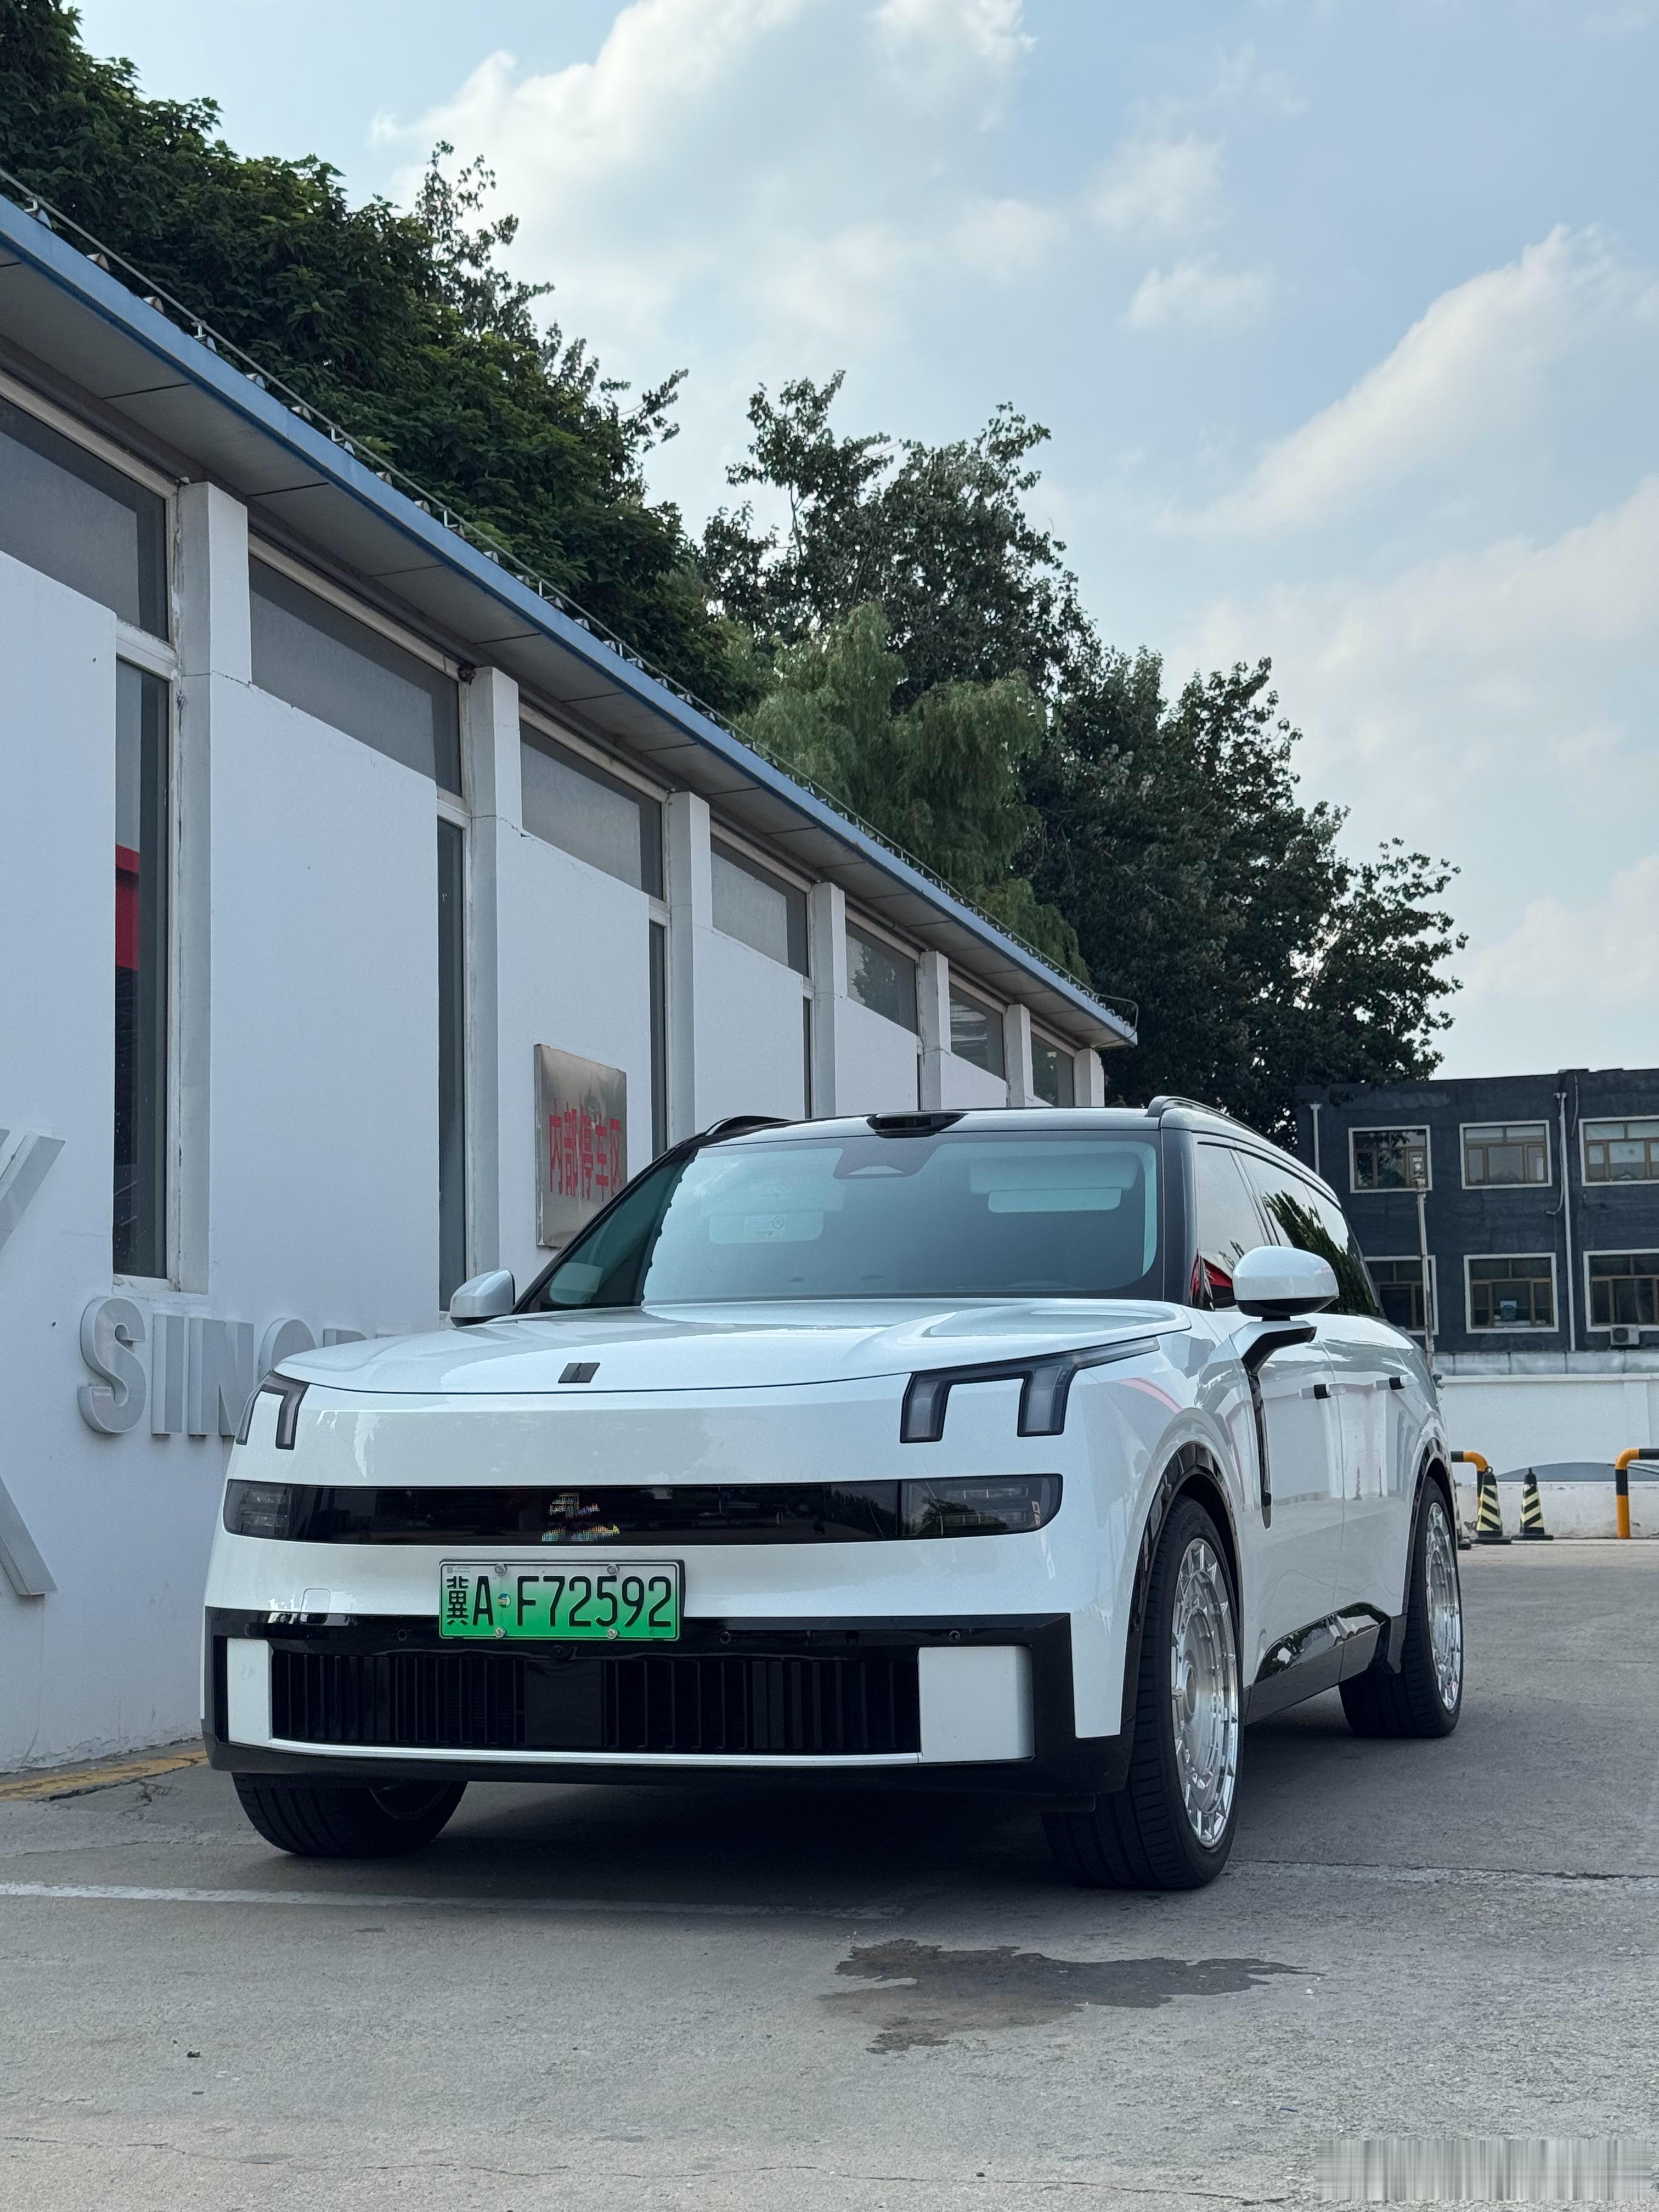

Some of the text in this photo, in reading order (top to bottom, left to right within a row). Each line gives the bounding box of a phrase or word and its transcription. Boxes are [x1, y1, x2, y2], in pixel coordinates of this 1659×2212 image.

[549, 1098, 622, 1202] 内部停车区
